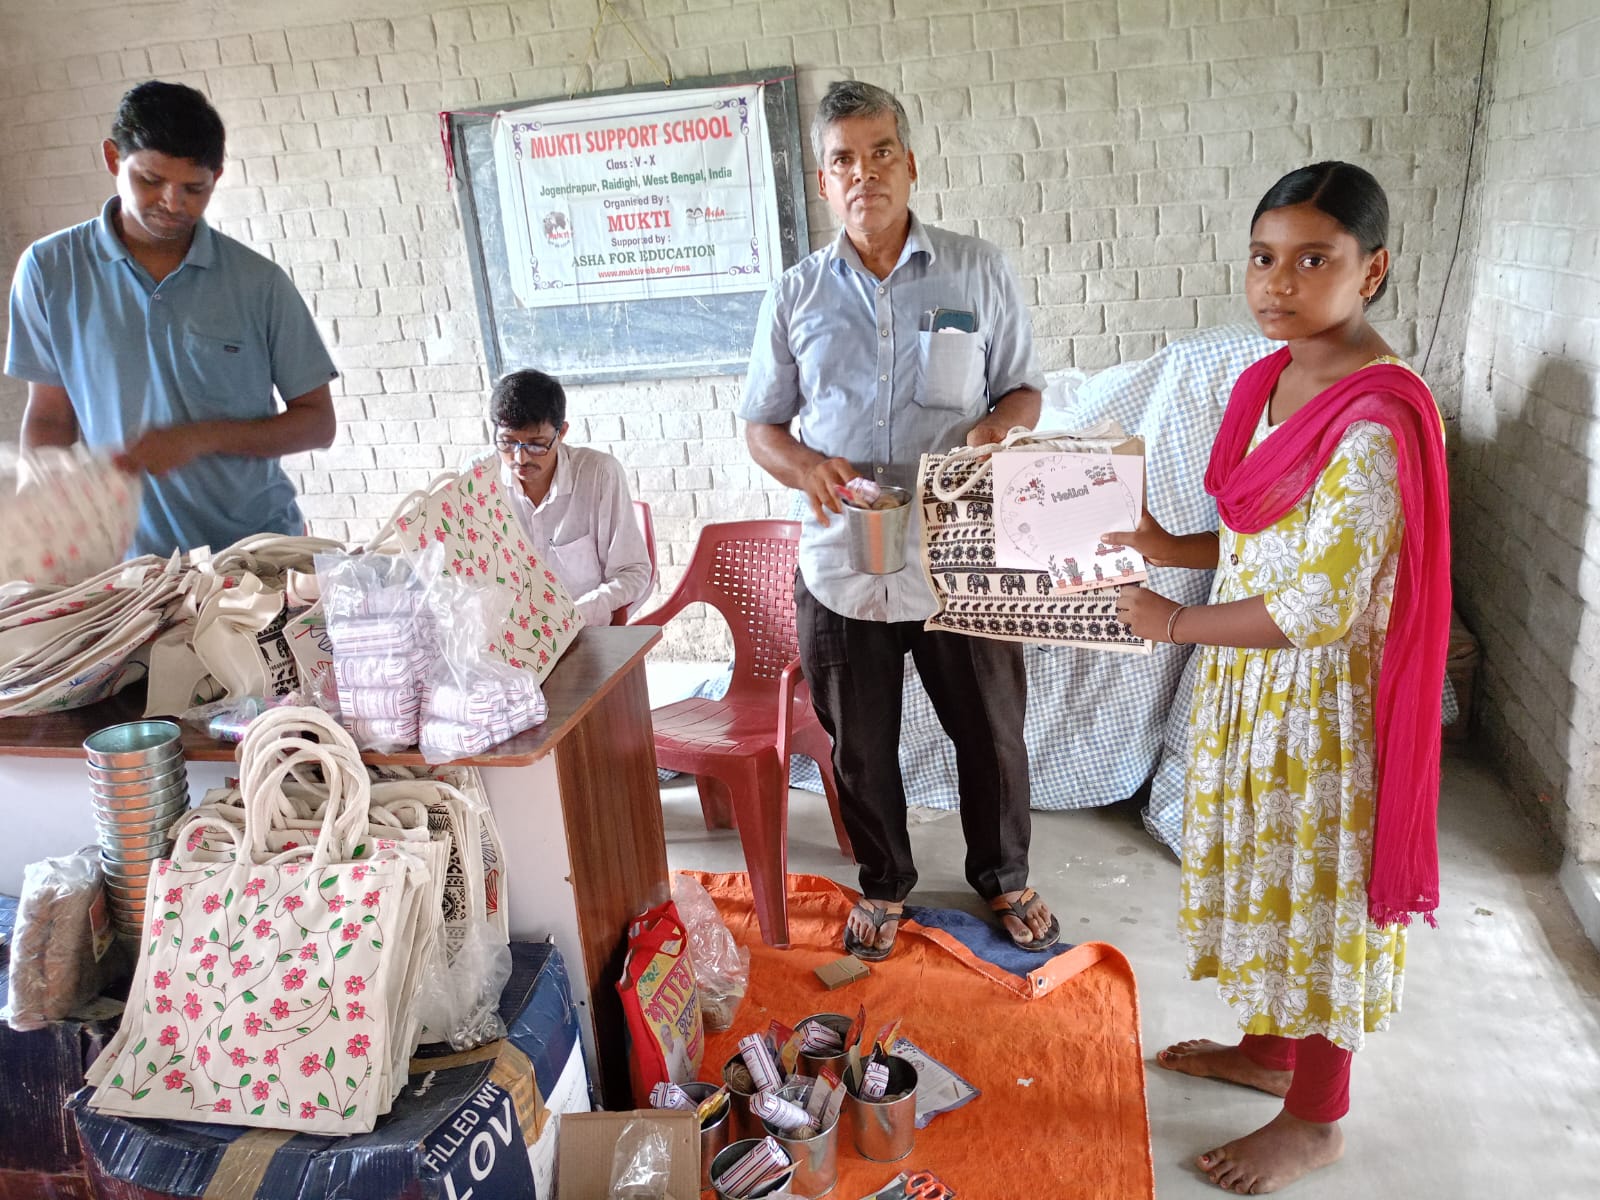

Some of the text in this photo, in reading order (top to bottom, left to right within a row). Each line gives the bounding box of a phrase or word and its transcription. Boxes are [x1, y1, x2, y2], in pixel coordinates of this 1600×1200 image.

[530, 116, 732, 159] MUKTI SUPPORT SCHOOL
[606, 158, 628, 170] Class
[650, 155, 656, 166] X
[540, 167, 732, 197] Jogendrapur, Raidighi, West Bengal, India
[604, 197, 649, 210] Organised
[652, 195, 664, 205] By
[607, 210, 672, 232] MUKTI
[655, 234, 666, 244] by
[572, 244, 716, 268] ASHA FOR EDUCATION
[424, 1080, 501, 1173] FILLED WI
